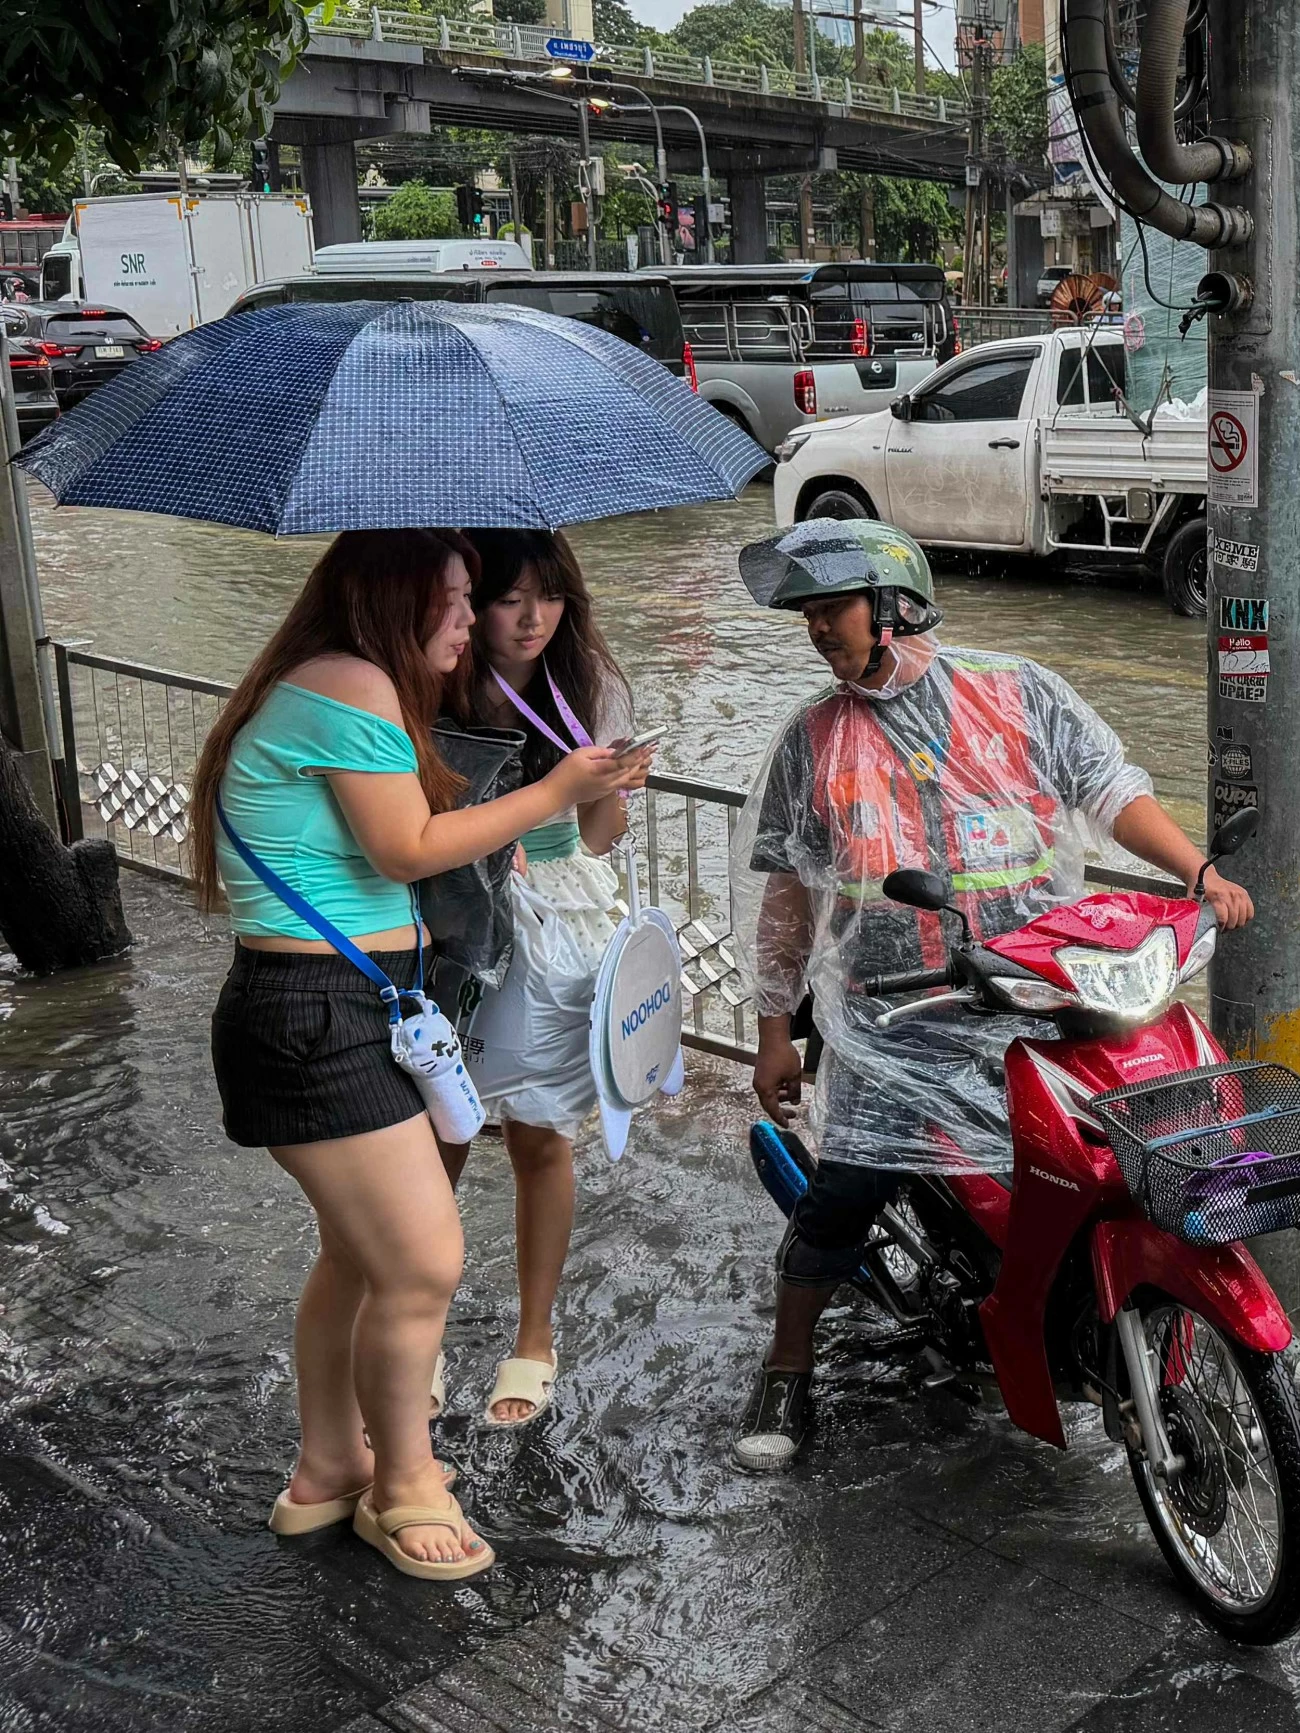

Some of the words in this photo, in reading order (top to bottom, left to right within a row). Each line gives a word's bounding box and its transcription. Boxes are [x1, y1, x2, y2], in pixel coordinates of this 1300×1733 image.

[120, 253, 147, 274] SNR
[1221, 597, 1267, 631] KNX
[1222, 757, 1251, 767] X-FILES
[1121, 1053, 1166, 1069] HONDA
[1029, 1165, 1081, 1192] HONDA
